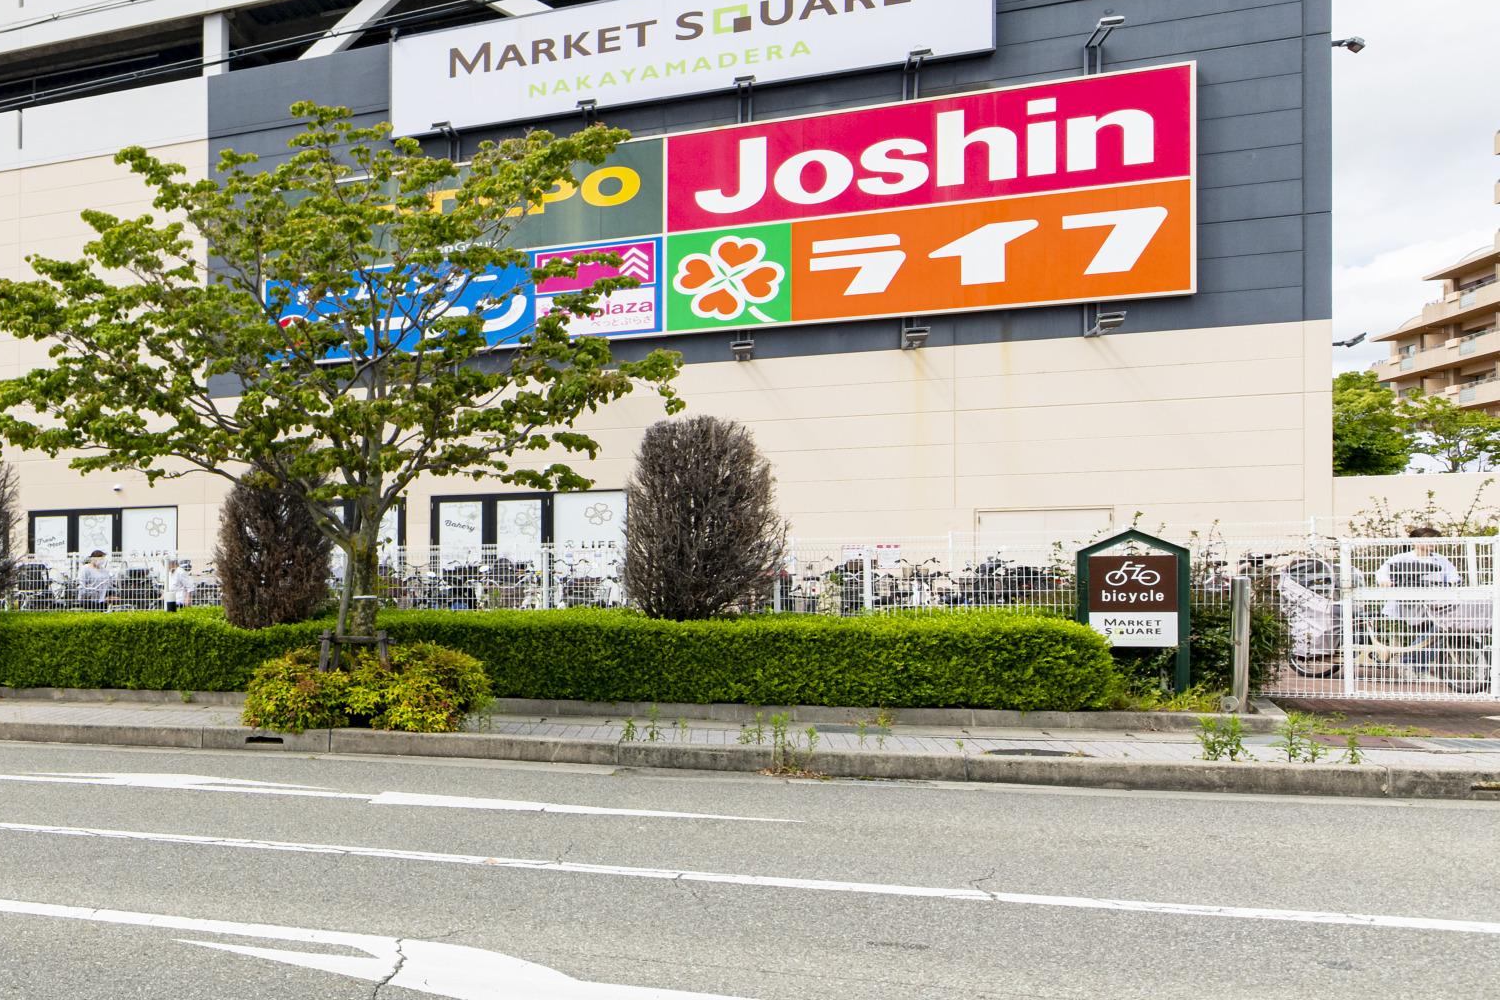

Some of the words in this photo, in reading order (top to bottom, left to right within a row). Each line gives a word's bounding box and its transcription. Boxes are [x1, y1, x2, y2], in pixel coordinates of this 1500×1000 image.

[449, 19, 658, 79] MARKET
[529, 40, 811, 99] NAKAYAMADERA
[694, 97, 1155, 214] Joshin
[809, 206, 1169, 297] ライフ
[444, 519, 476, 533] Bakery
[581, 540, 617, 549] LIFE
[1101, 589, 1165, 604] bicycle
[1104, 618, 1162, 627] MARKET
